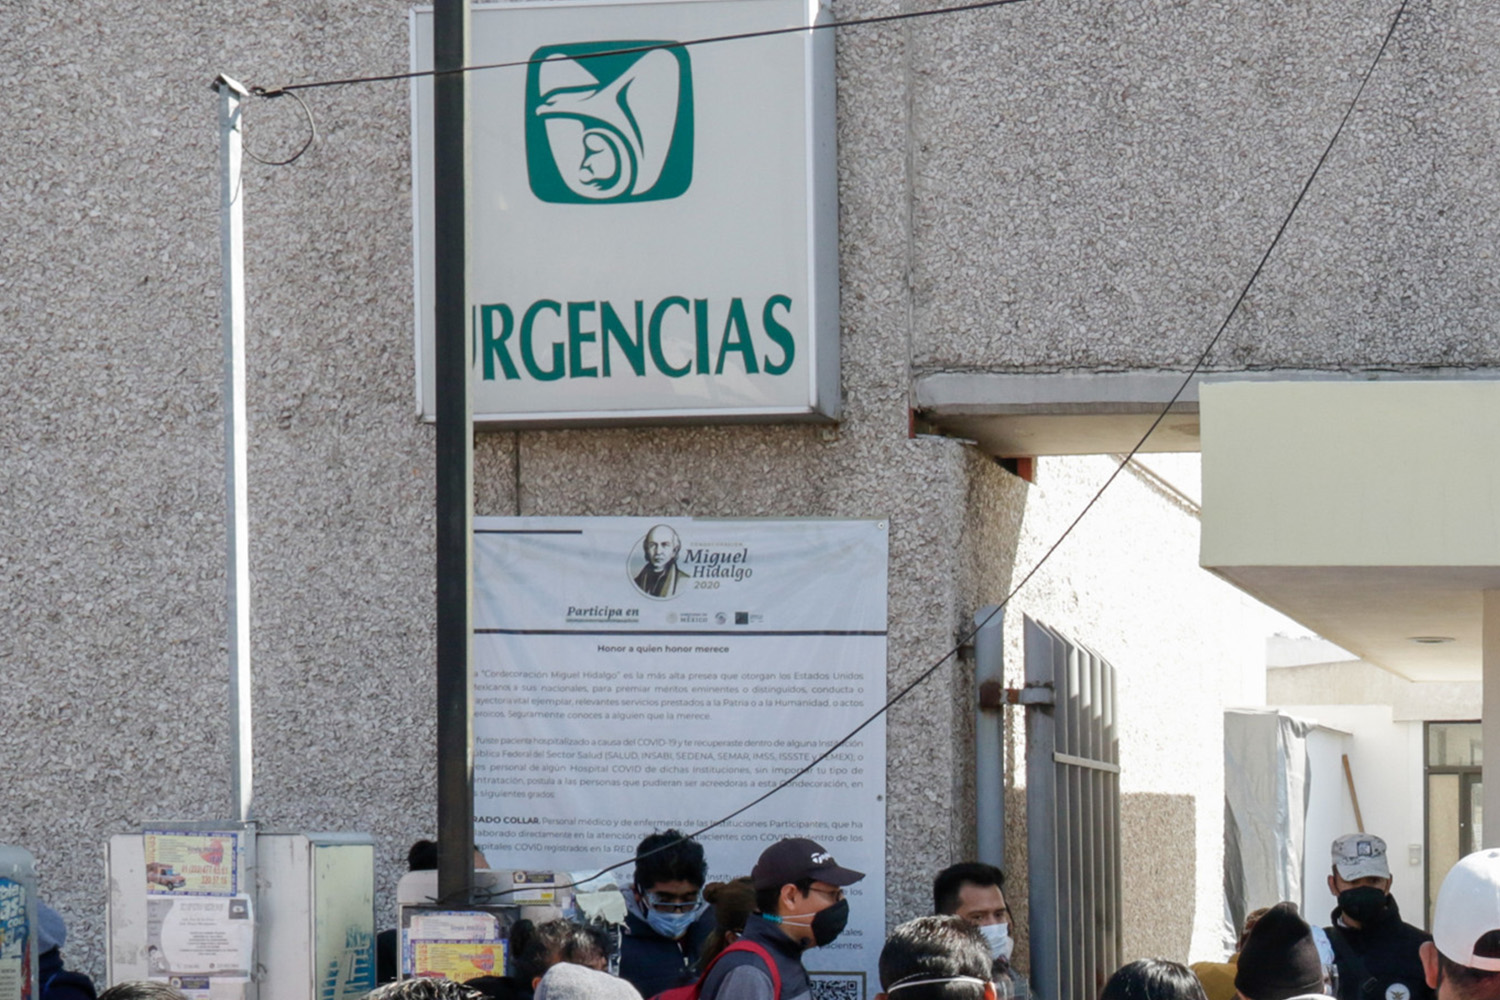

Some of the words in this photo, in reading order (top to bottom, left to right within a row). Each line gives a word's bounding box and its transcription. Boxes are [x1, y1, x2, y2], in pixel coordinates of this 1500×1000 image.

[473, 294, 795, 382] RGENCIAS
[684, 548, 748, 567] Miguel
[693, 565, 753, 582] Hidalgo
[694, 581, 720, 590] 2020
[566, 606, 622, 619] Participa
[626, 608, 639, 617] en
[597, 644, 626, 652] Honor
[635, 644, 663, 653] quien
[664, 644, 692, 653] honor
[550, 670, 580, 681] Miguel
[635, 671, 644, 679] la
[646, 671, 666, 680] más
[668, 671, 685, 680] alta
[687, 672, 718, 681] presea
[719, 673, 738, 681] que
[741, 673, 776, 681] otorgan
[778, 672, 791, 680] los
[793, 671, 830, 680] Estados
[832, 671, 864, 680] Unidos
